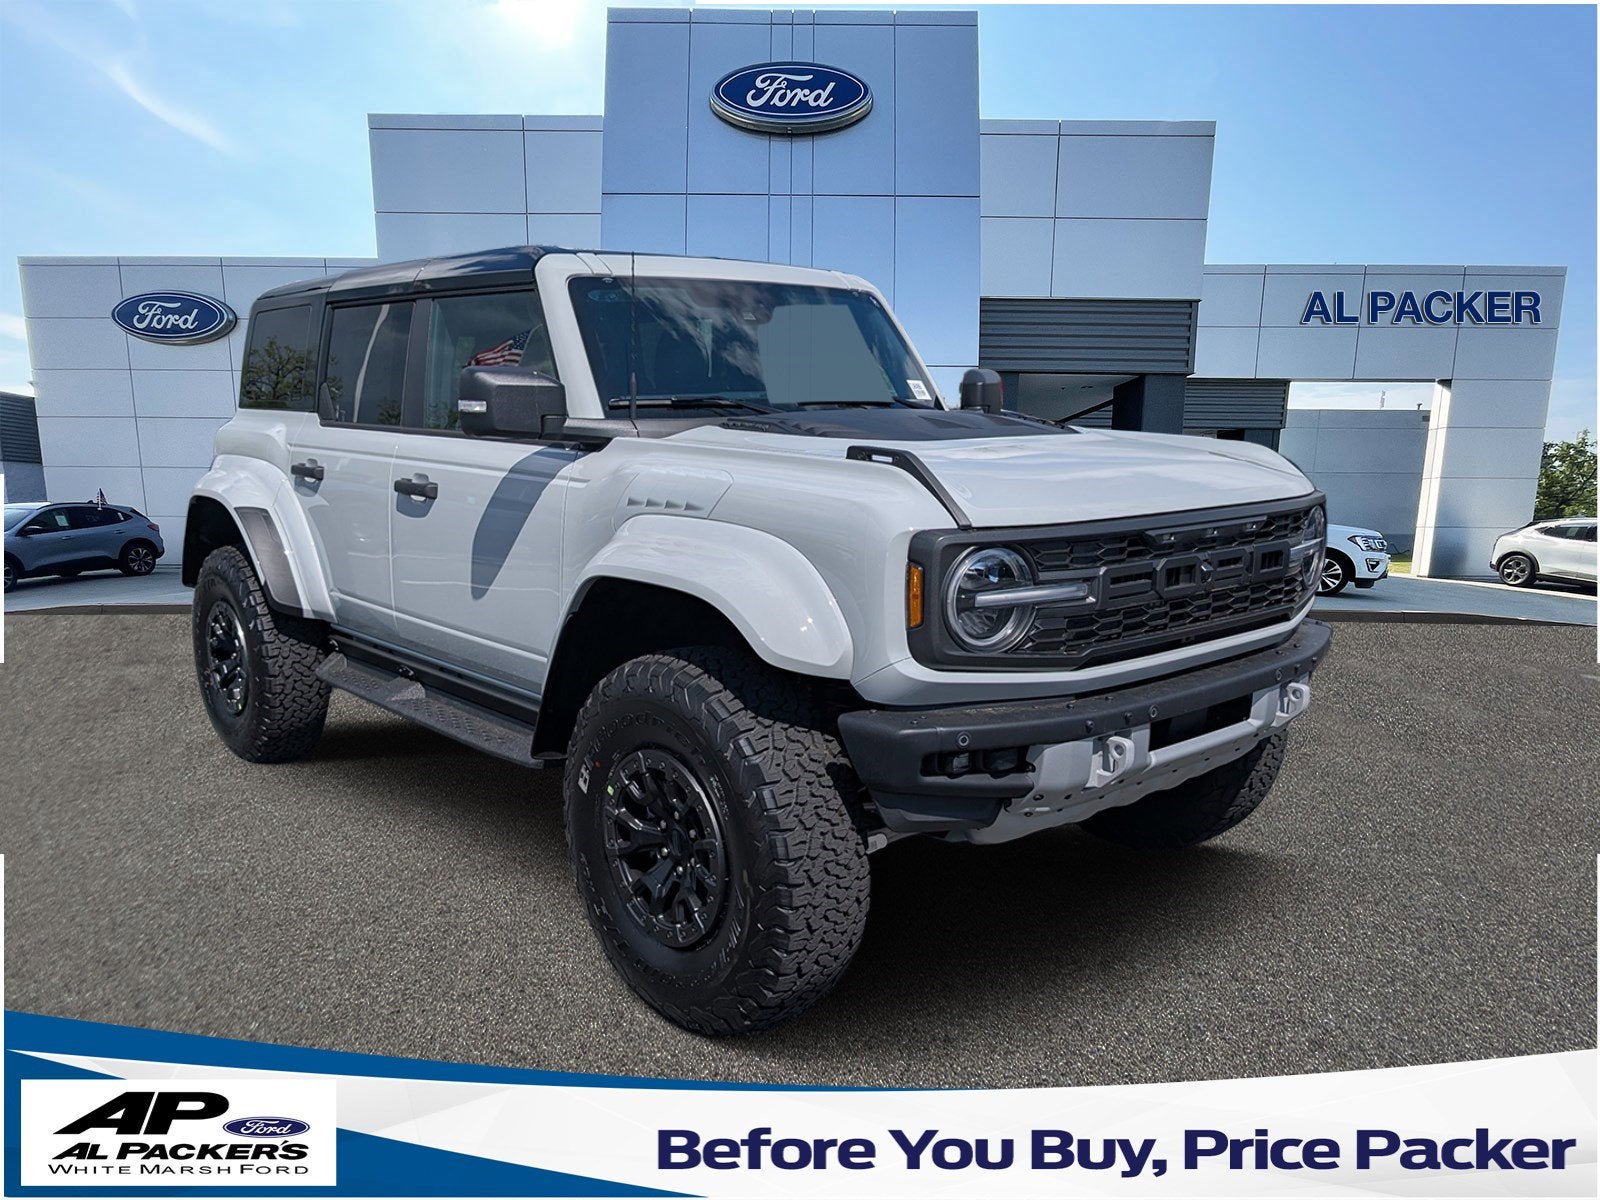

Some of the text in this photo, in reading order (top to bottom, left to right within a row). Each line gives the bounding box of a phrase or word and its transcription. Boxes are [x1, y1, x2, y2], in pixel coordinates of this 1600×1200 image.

[746, 73, 836, 107] Ford
[133, 301, 199, 329] Ford
[1302, 290, 1542, 324] AL PACKER
